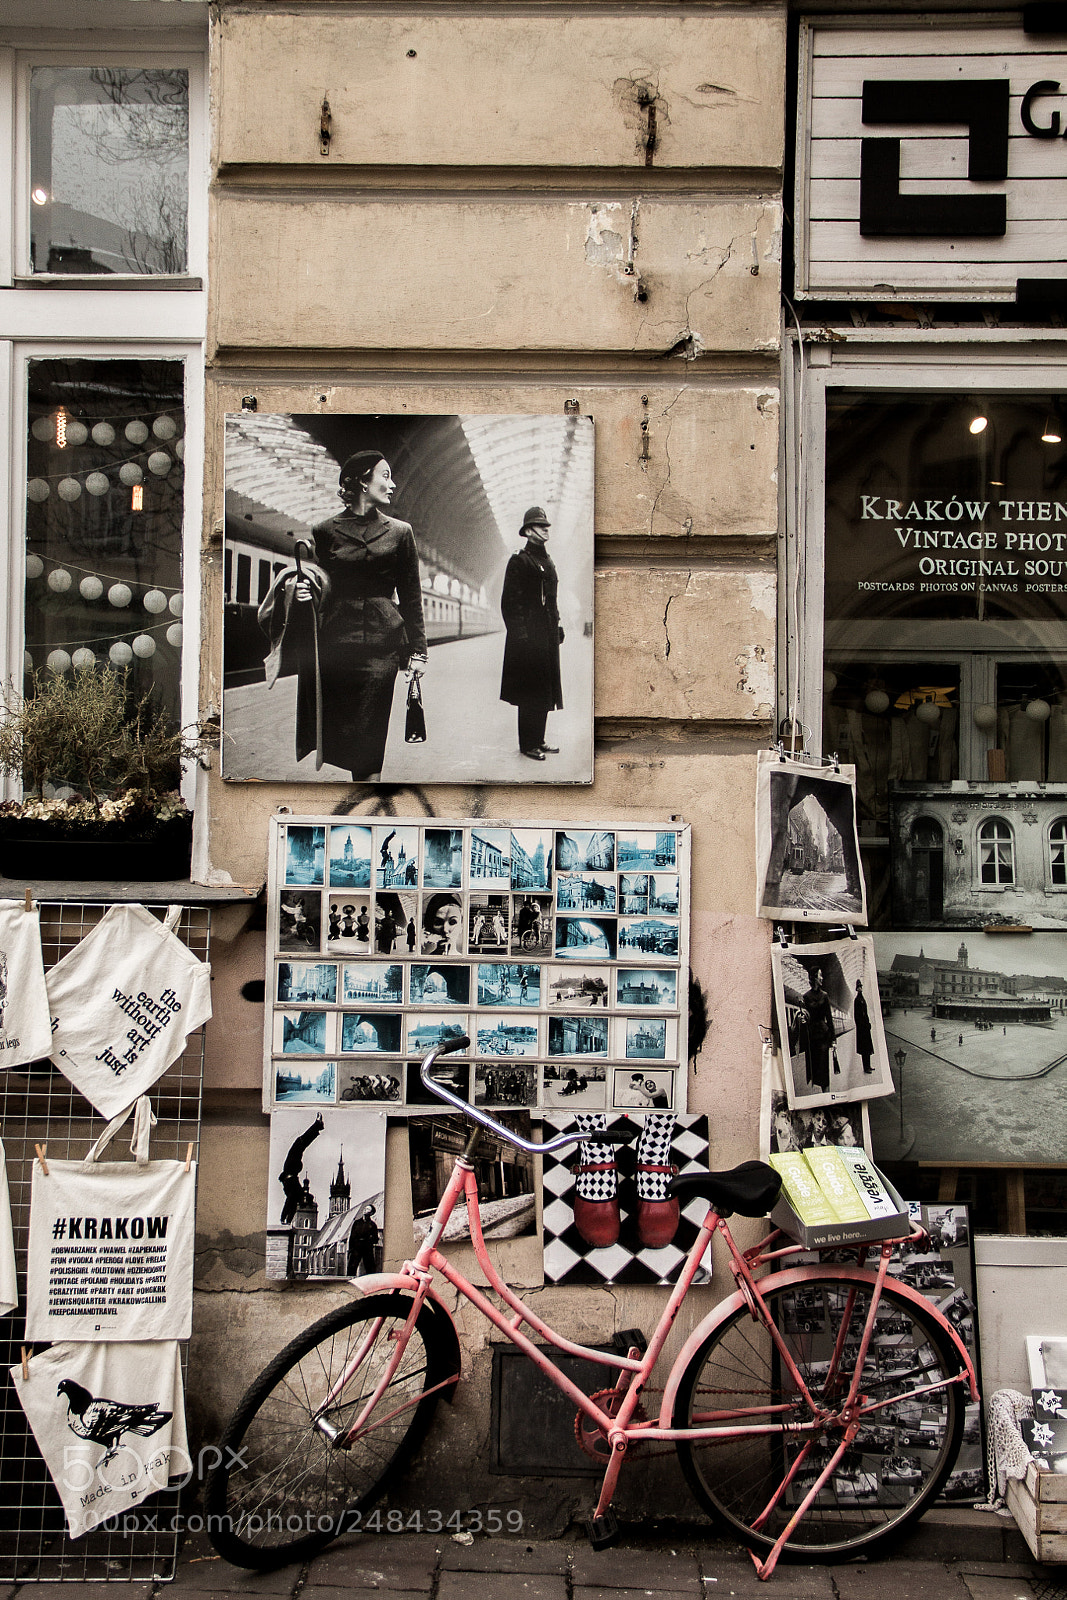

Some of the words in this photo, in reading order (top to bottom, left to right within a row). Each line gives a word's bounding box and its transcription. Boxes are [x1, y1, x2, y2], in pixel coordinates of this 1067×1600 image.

[860, 495, 990, 521] KRAKÓW
[895, 528, 998, 550] VINTAGE
[919, 557, 1019, 576] ORIGINAL
[858, 581, 915, 592] POSTCARDS
[920, 583, 958, 592] PHOTOS
[960, 583, 976, 592] ON
[979, 583, 1019, 592] CANVAS
[137, 992, 171, 1027] earth
[160, 988, 182, 1012] the
[112, 988, 162, 1039] without
[127, 1029, 151, 1051] art
[95, 1046, 127, 1076] just
[123, 1045, 139, 1064] is
[854, 1163, 883, 1203] veggie
[52, 1216, 168, 1240] #KRAKOW
[814, 1236, 826, 1244] we
[827, 1233, 841, 1242] live
[80, 1484, 112, 1507] Made
[121, 1472, 137, 1487] in
